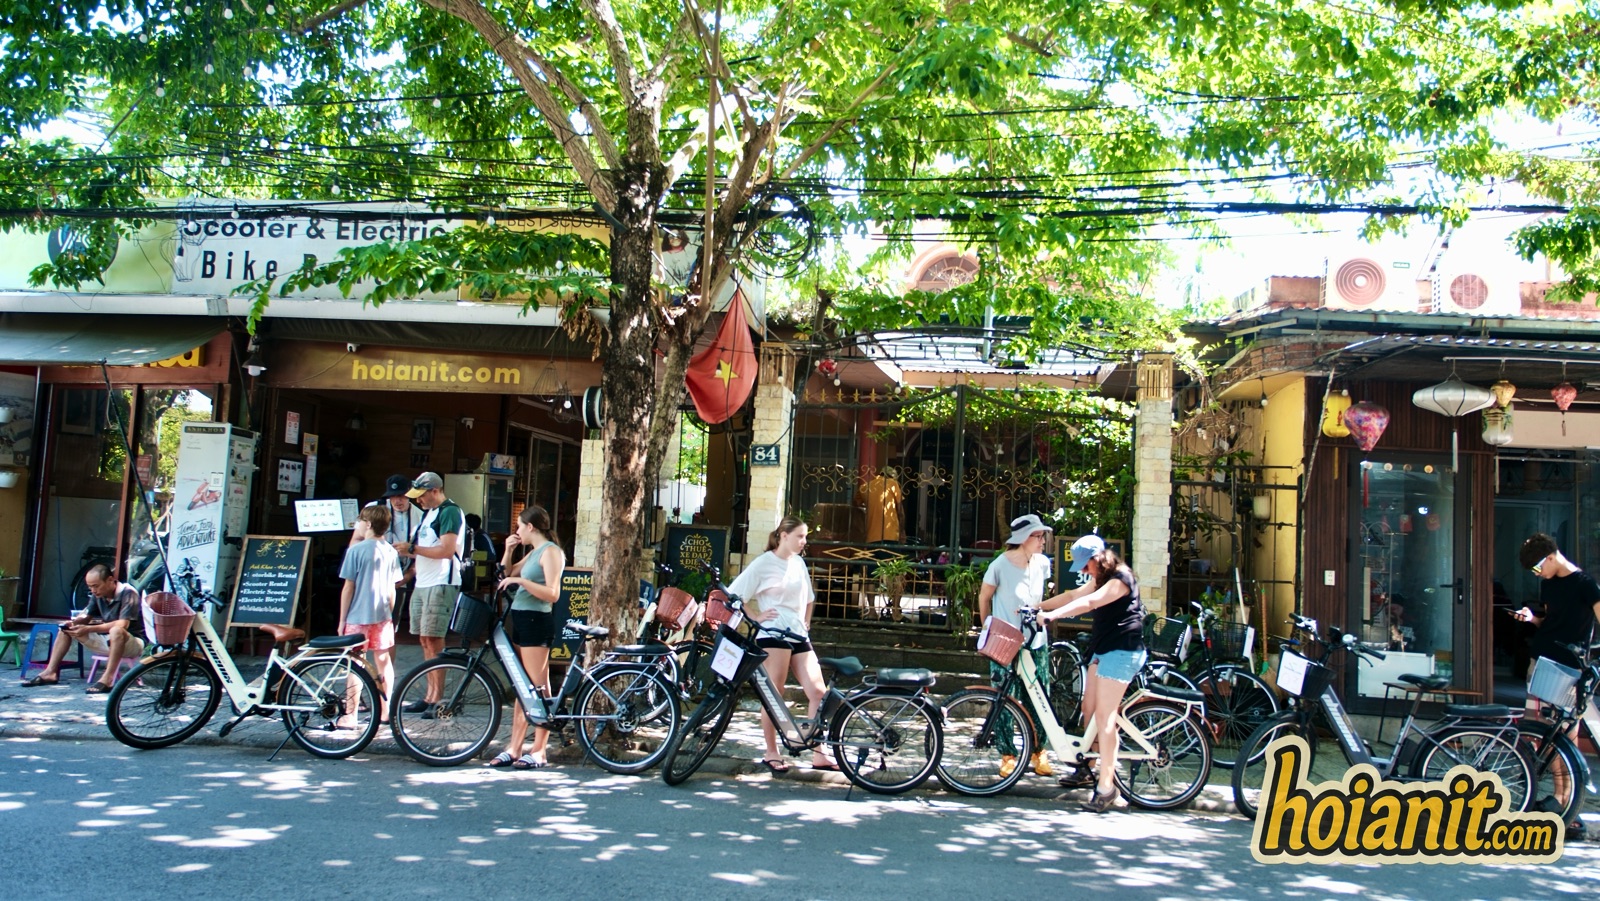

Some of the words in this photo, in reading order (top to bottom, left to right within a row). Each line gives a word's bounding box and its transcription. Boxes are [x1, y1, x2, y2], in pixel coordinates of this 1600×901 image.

[183, 218, 298, 239] Scooter
[305, 218, 326, 240] &
[336, 218, 447, 242] Electric
[507, 216, 543, 228] BEST
[201, 250, 278, 281] Bike
[351, 359, 521, 385] hoianit.com
[754, 446, 778, 461] 84
[177, 531, 216, 550] ADVENTURE
[687, 538, 705, 546] CHO
